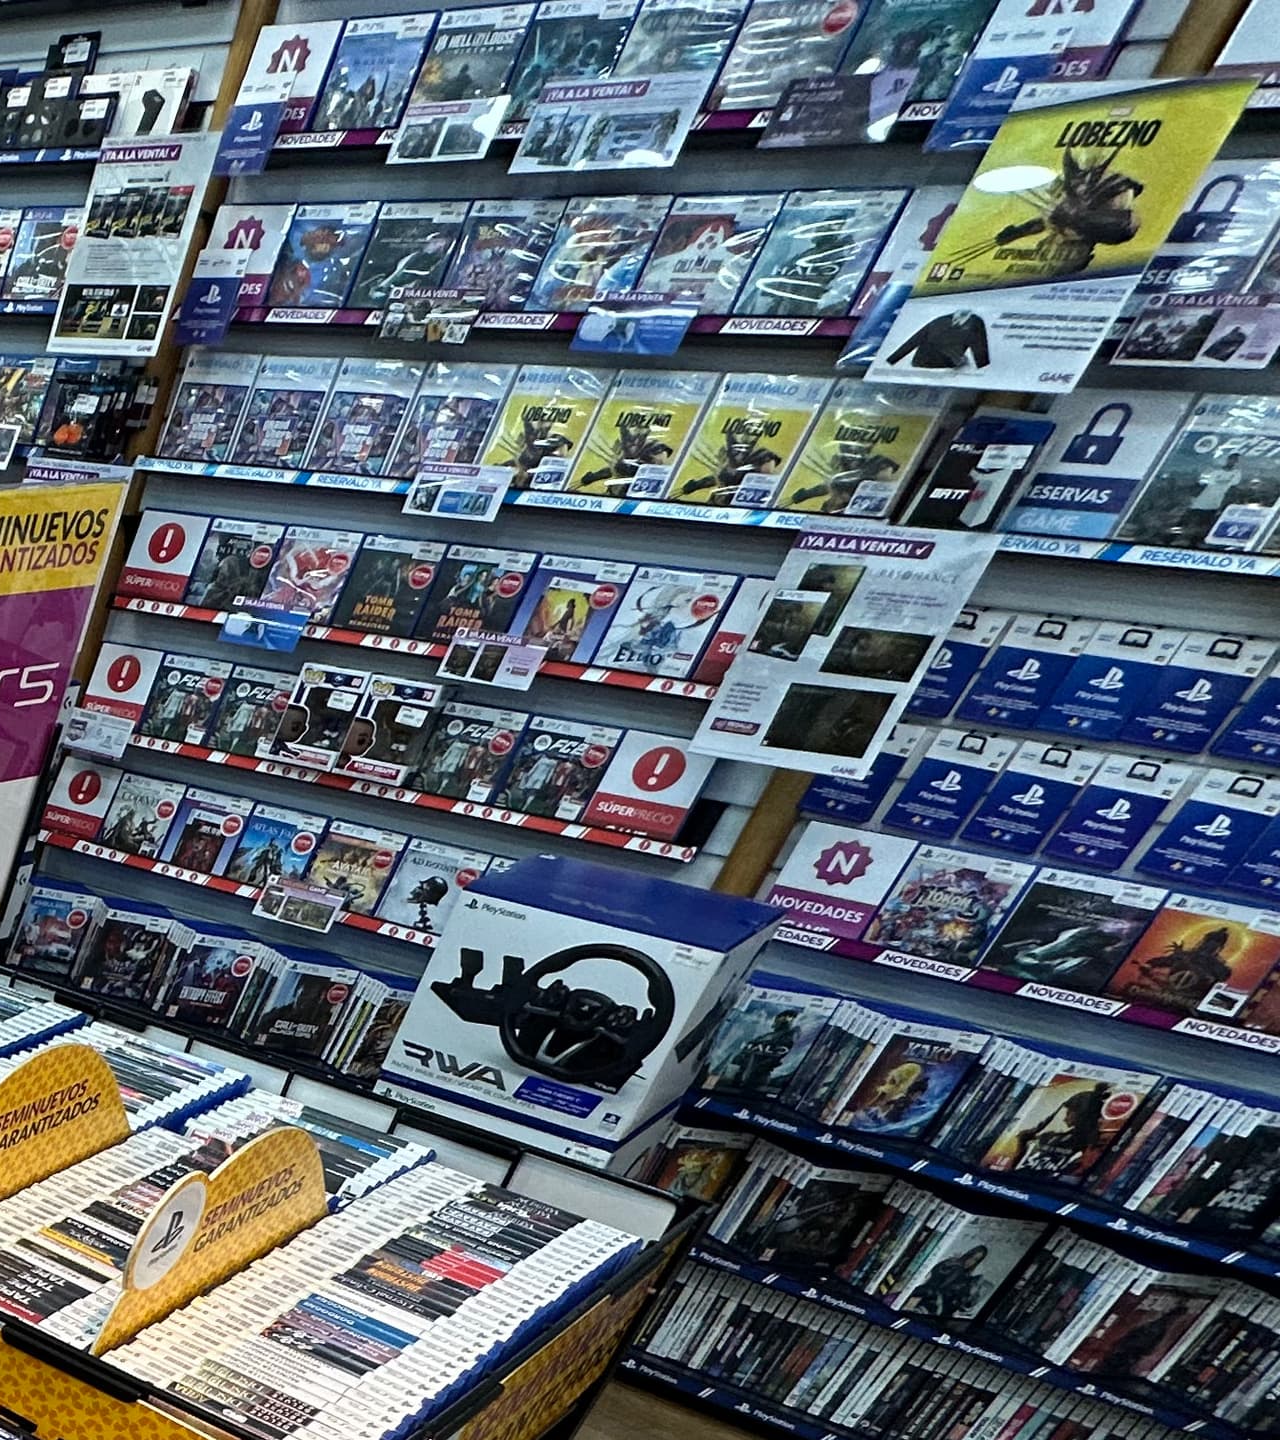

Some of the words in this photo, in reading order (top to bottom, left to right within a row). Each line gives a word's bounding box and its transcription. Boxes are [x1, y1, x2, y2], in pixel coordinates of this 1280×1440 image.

[279, 134, 336, 146] NOVEDADES
[1055, 118, 1163, 148] LOBEZNO
[137, 147, 169, 159] VENTA!
[270, 309, 328, 322] NOVEDADES
[480, 313, 544, 327] NOVEDADES
[730, 318, 808, 333] NOVEDADES
[1028, 485, 1113, 503] ESERVAS
[800, 535, 822, 549] ¡YA
[838, 538, 856, 551] LA
[858, 539, 911, 556] VENTA!
[1232, 557, 1257, 571] YA
[353, 603, 394, 623] RAIDER
[596, 801, 674, 826] SÚPERPRECIO
[481, 904, 526, 921] PlayStation
[769, 893, 864, 925] NOVEDADES
[883, 951, 962, 980] NOVEDADES
[1026, 984, 1114, 1012] NOVEDADES
[1185, 1019, 1279, 1050] NOVEDADES
[402, 1040, 506, 1090] RWA
[752, 1112, 799, 1134] PlayStation
[836, 1137, 884, 1159] PlayStation
[200, 1163, 297, 1229] SEMINUEVOS
[977, 1178, 1029, 1201] PlayStation
[193, 1176, 303, 1252] GARANTIZADOS
[1133, 1224, 1190, 1248] PlayStation
[954, 1339, 1004, 1363] PlayStation
